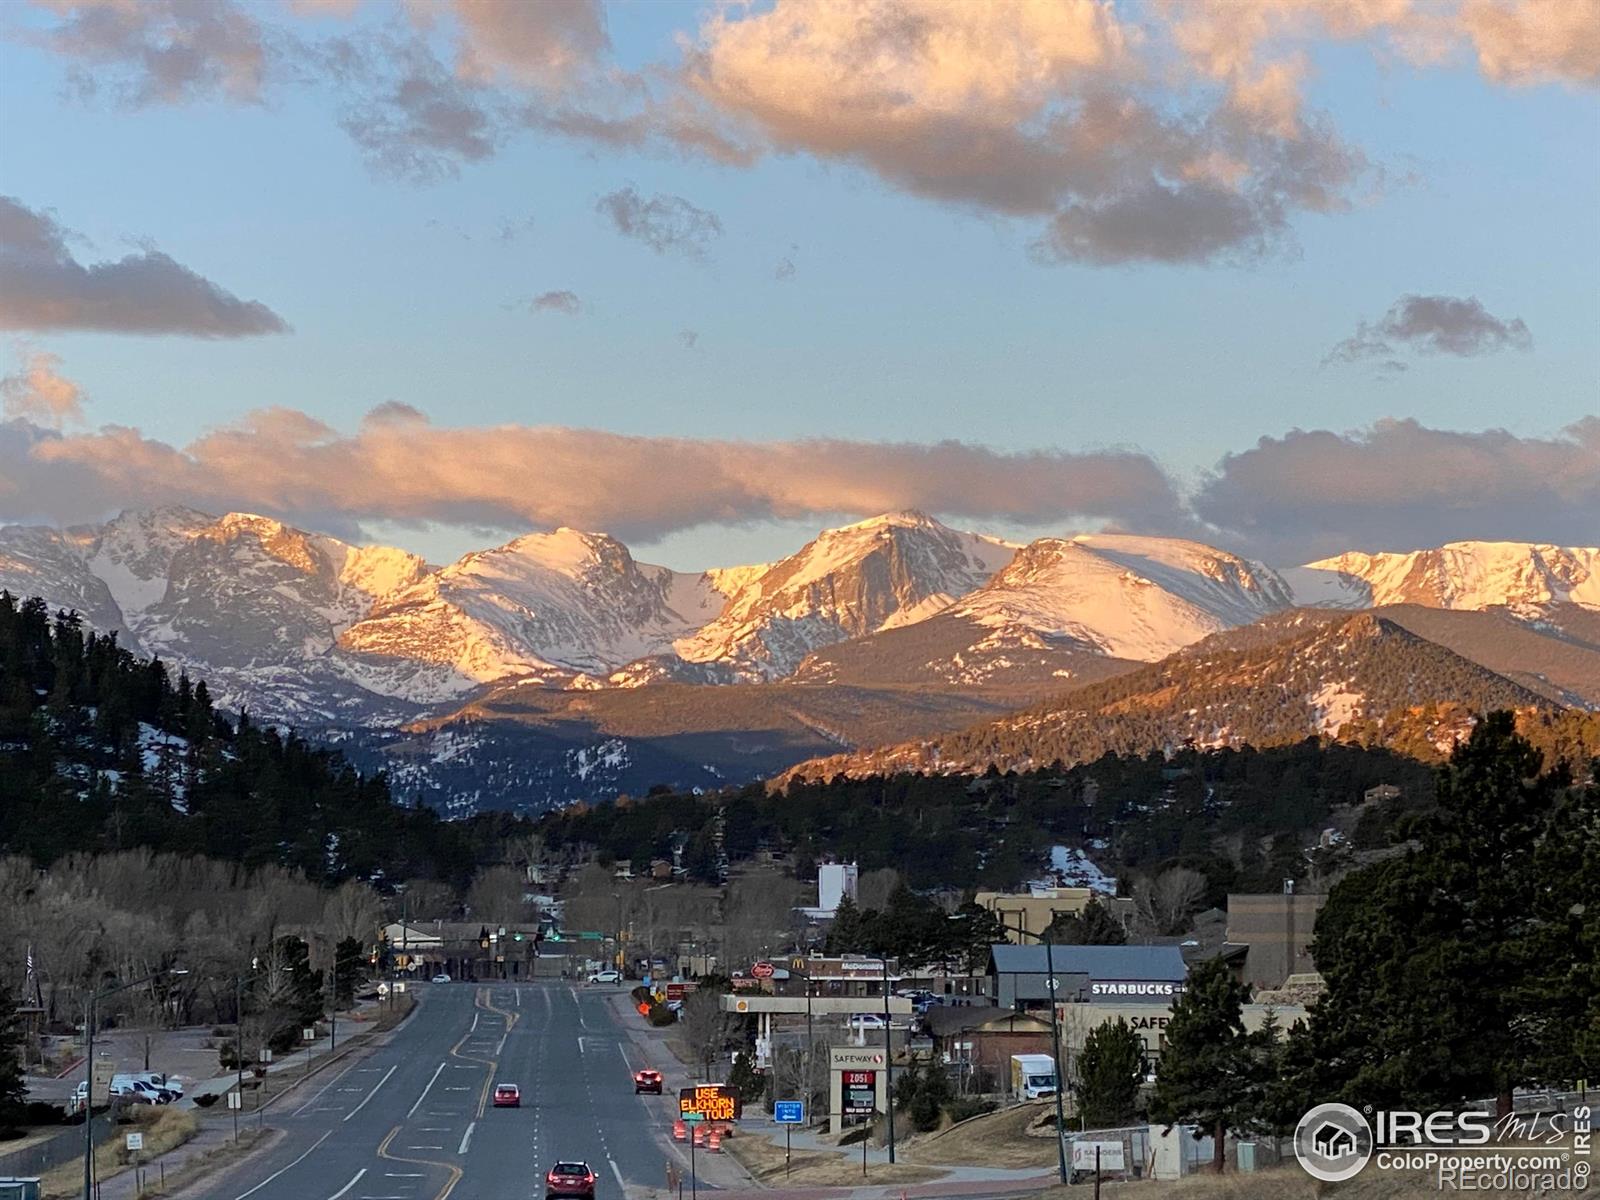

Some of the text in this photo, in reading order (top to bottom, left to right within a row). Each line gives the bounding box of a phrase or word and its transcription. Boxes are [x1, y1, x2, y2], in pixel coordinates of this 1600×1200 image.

[841, 962, 884, 970] McDonald's
[1092, 984, 1173, 995] STARBUCKS
[834, 1055, 872, 1063] SAFEWAY
[695, 1088, 719, 1100] USE
[680, 1097, 735, 1111] ELKHORN
[689, 1109, 735, 1120] TOUR
